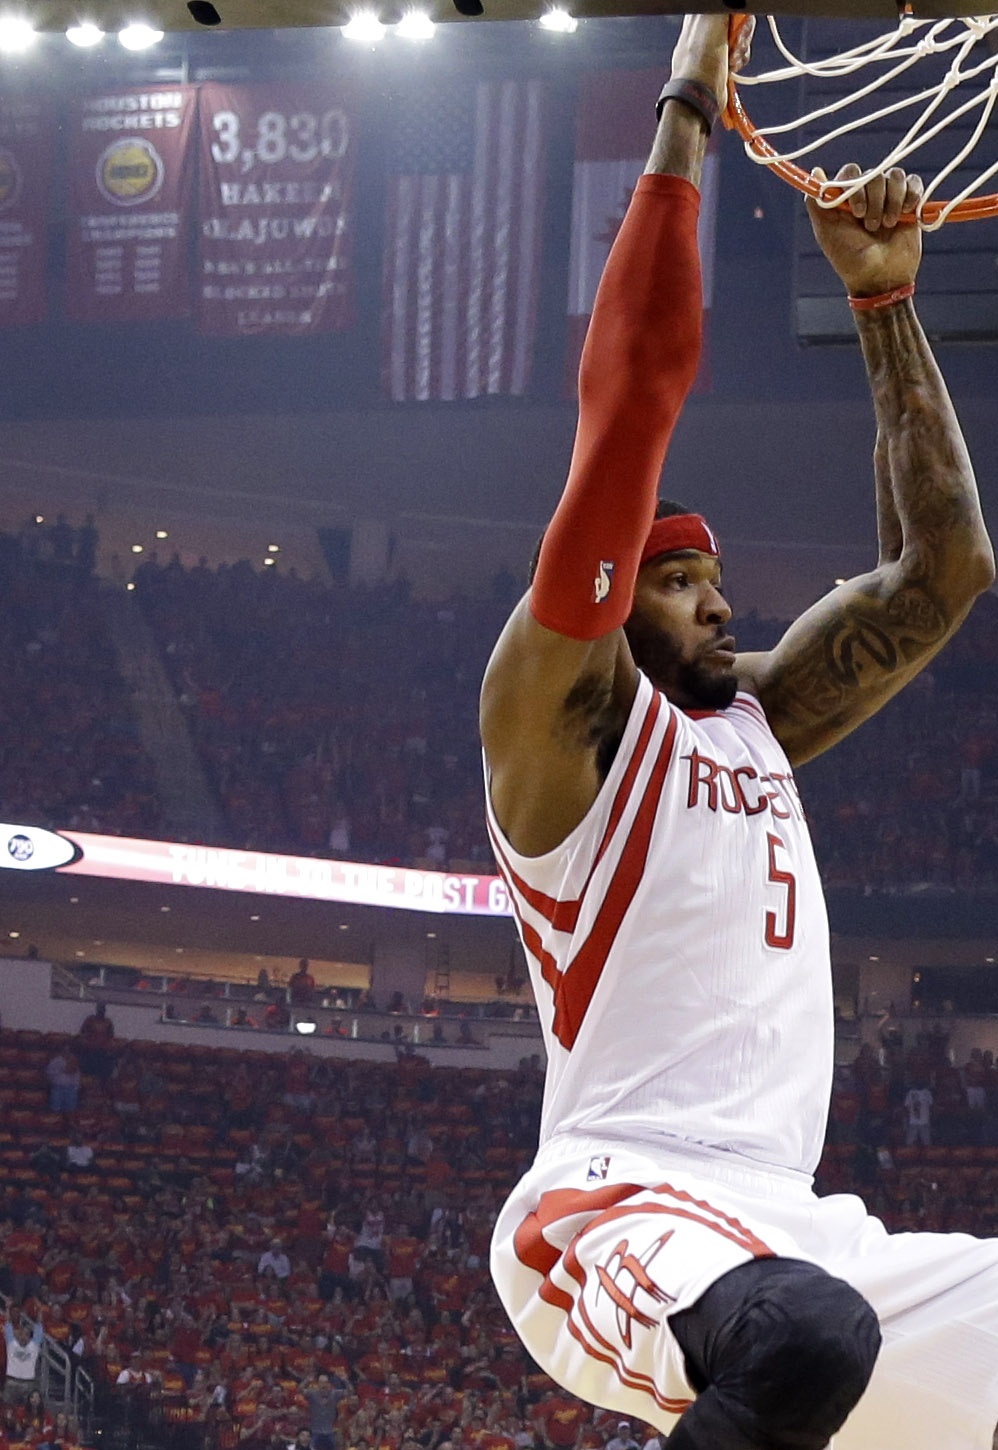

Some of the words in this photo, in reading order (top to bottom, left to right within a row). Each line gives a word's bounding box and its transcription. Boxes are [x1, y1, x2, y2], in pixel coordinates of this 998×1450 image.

[211, 109, 349, 174] 3,830
[404, 873, 479, 911] POST
[488, 879, 514, 913] G
[765, 831, 796, 950] 5
